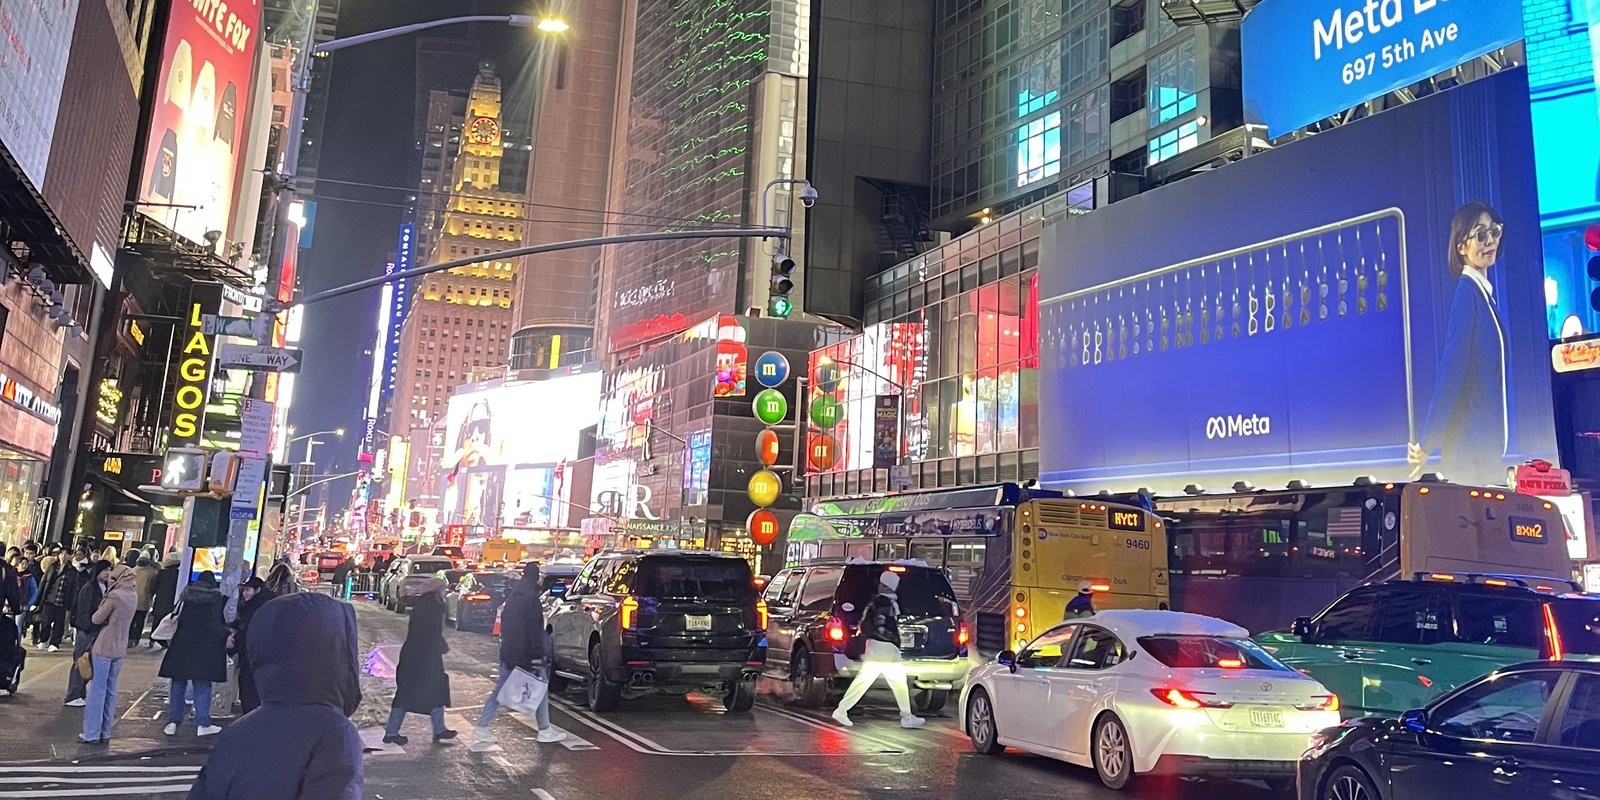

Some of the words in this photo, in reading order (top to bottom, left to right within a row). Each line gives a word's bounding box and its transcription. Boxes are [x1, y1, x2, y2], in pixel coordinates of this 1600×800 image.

[225, 13, 250, 52] FOX
[1313, 0, 1402, 60] Meta
[1342, 52, 1376, 85] 697
[1382, 38, 1414, 68] 5th
[1421, 23, 1458, 53] Ave
[230, 354, 252, 363] ONE
[266, 355, 289, 366] WAY
[174, 303, 210, 437] LAGOS
[389, 351, 398, 389] VEGAS
[763, 363, 777, 376] m
[767, 400, 780, 413] m
[1228, 414, 1270, 437] Meta
[755, 482, 767, 494] m
[1520, 480, 1542, 489] RAY'S
[1543, 481, 1568, 490] PIZZA
[631, 484, 661, 520] R
[1114, 512, 1138, 526] NYCT
[761, 521, 774, 534] m
[1516, 524, 1543, 538] BXM2
[1126, 538, 1150, 550] 9460
[1113, 577, 1128, 585] bus
